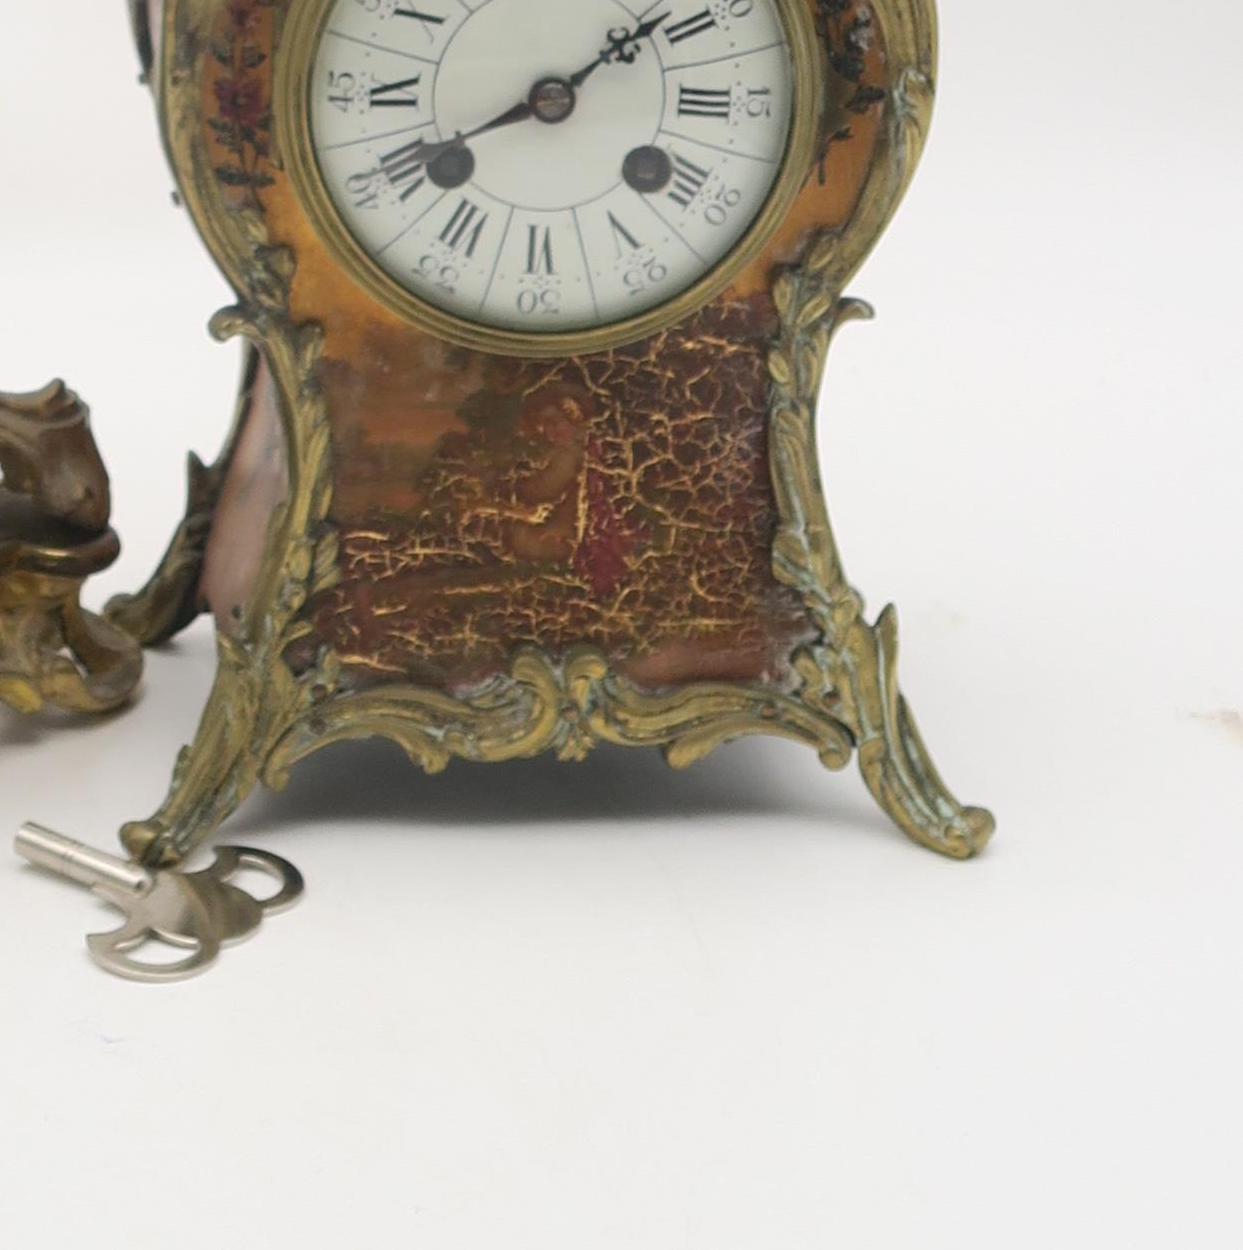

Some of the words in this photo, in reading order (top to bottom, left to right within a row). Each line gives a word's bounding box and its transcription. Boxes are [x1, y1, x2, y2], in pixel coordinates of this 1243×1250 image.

[662, 5, 719, 47] II
[328, 70, 355, 112] 45
[367, 71, 422, 111] IX
[677, 82, 732, 125] III
[746, 86, 772, 118] 15
[344, 173, 379, 211] 40
[667, 151, 714, 211] IIII
[703, 182, 742, 226] 20
[438, 197, 489, 260] VII
[524, 223, 560, 276] VI
[605, 208, 643, 260] V
[411, 254, 459, 295] 35
[623, 255, 667, 296] 25
[517, 288, 561, 315] 30
